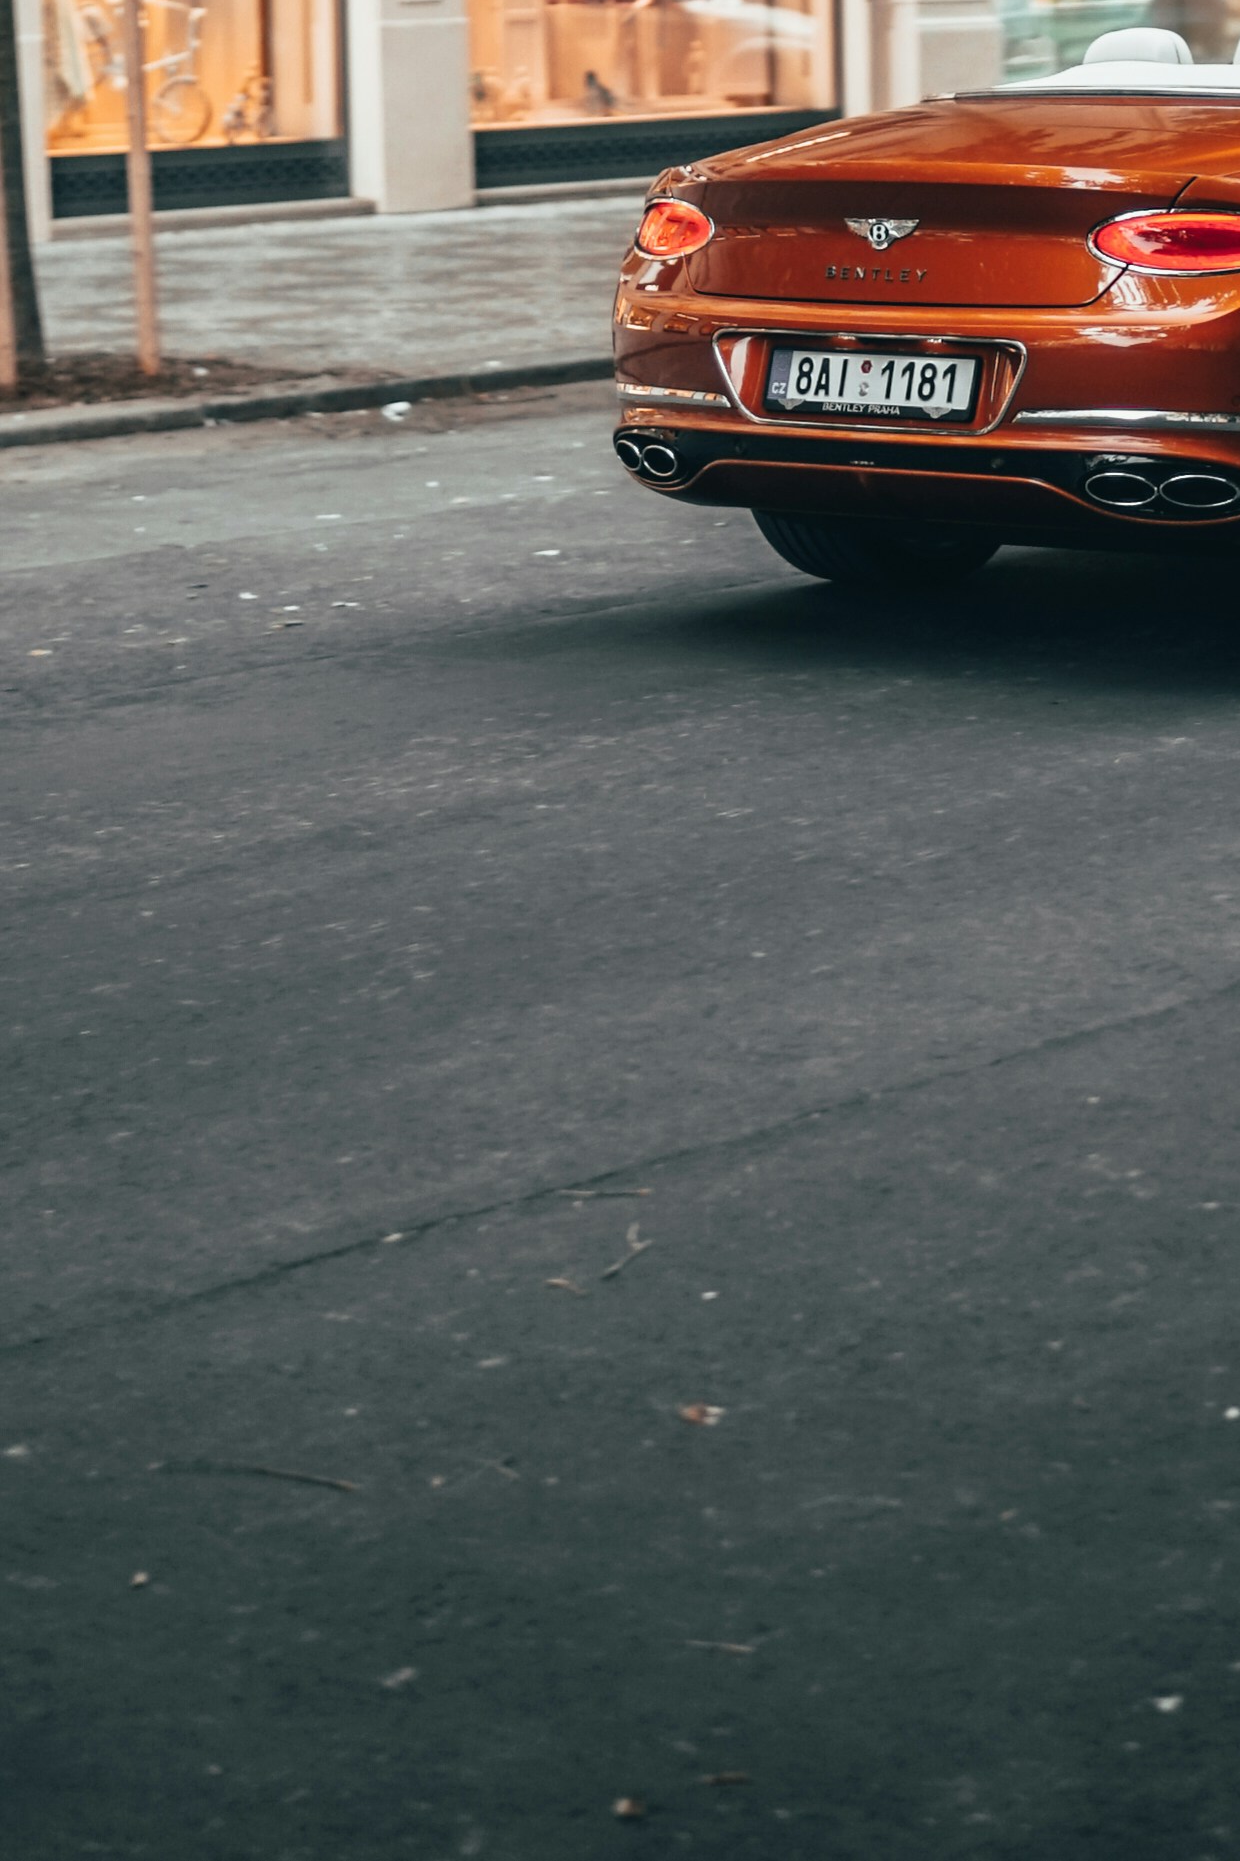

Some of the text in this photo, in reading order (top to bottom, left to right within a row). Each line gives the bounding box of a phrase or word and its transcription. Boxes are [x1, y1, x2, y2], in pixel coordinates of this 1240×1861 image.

[825, 265, 927, 282] BENTLEY
[795, 356, 957, 404] 8AI 1181
[771, 382, 786, 394] CZ
[822, 401, 900, 415] BENTLEY PRAHA
